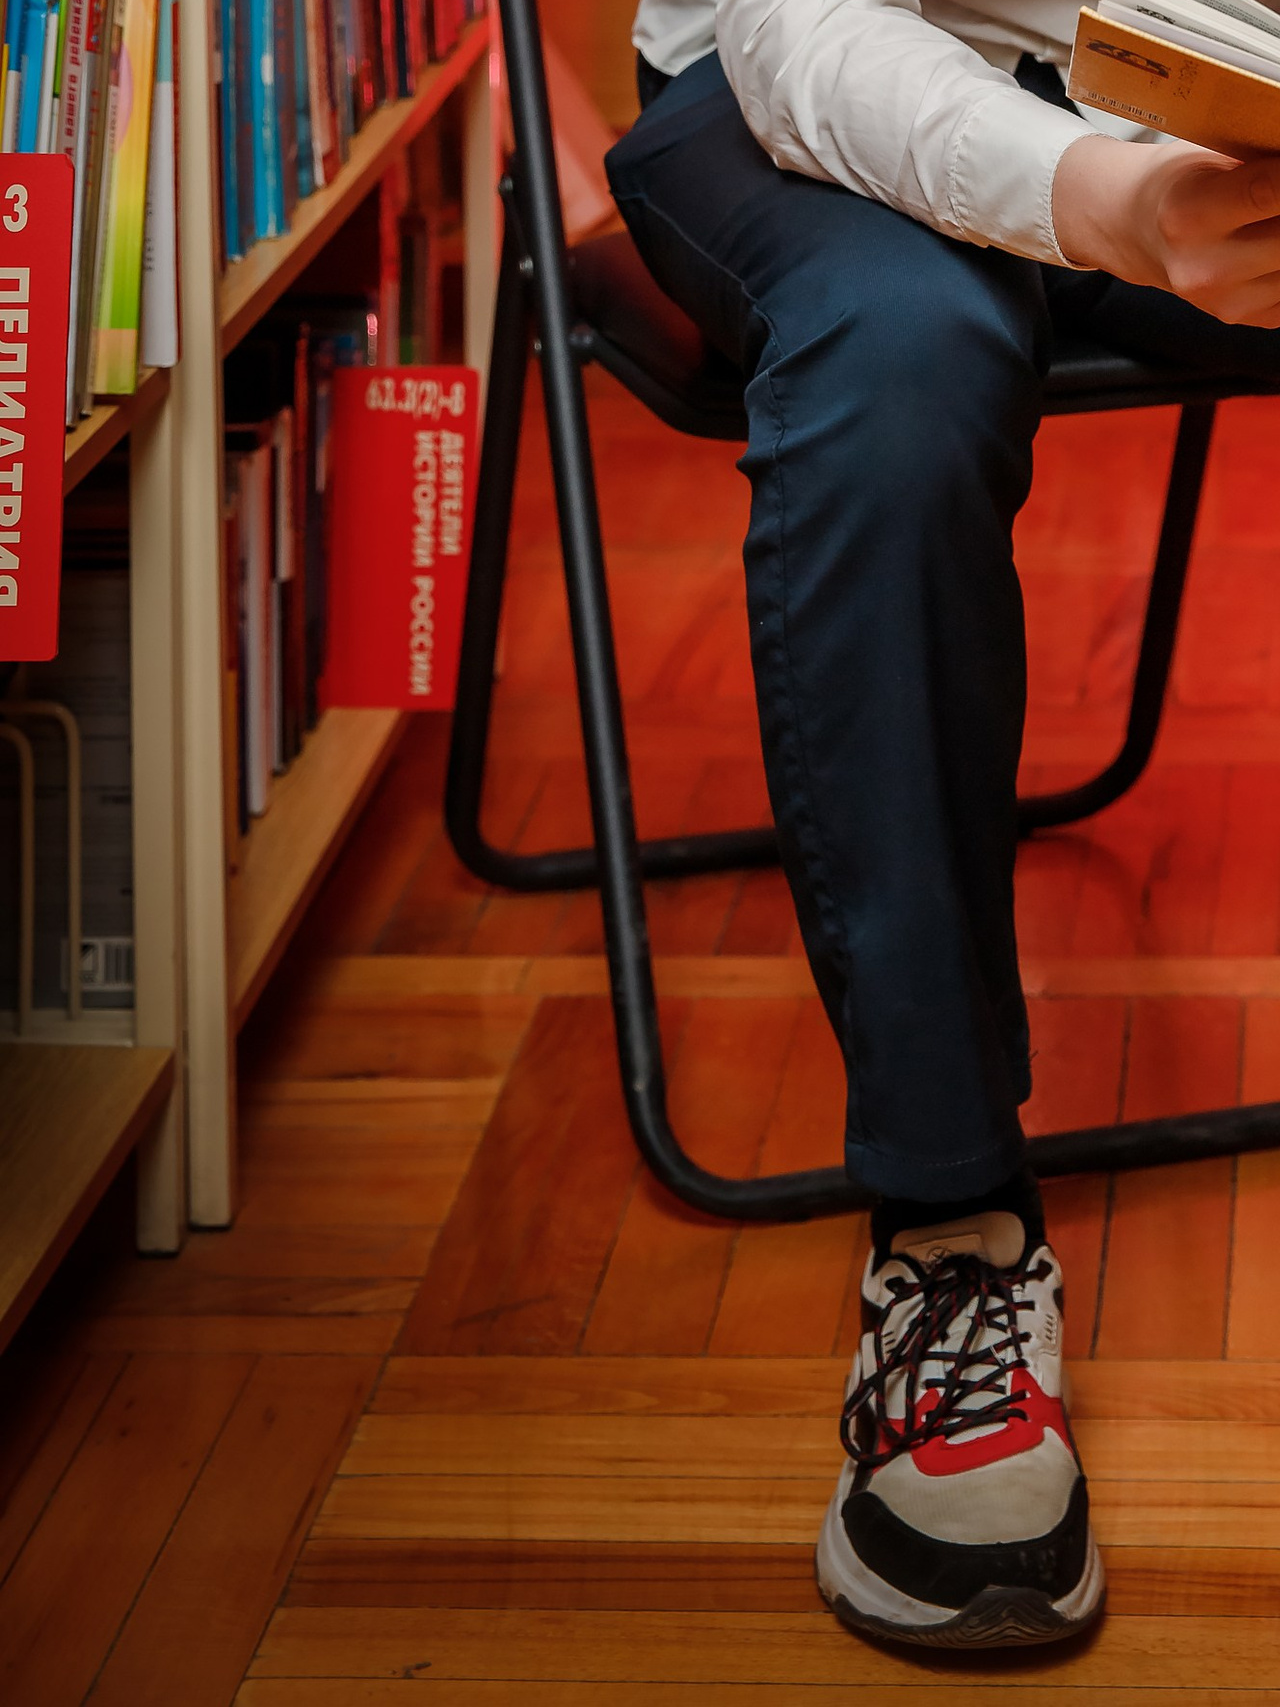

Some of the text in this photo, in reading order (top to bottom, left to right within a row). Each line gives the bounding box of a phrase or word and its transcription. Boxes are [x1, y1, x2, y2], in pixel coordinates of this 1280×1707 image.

[0, 267, 30, 608] ПЕДИАТРИЯ
[409, 430, 438, 696] ИСТОРИИ РОССИИ
[439, 429, 465, 556] ДЕЯТЕЛИ
